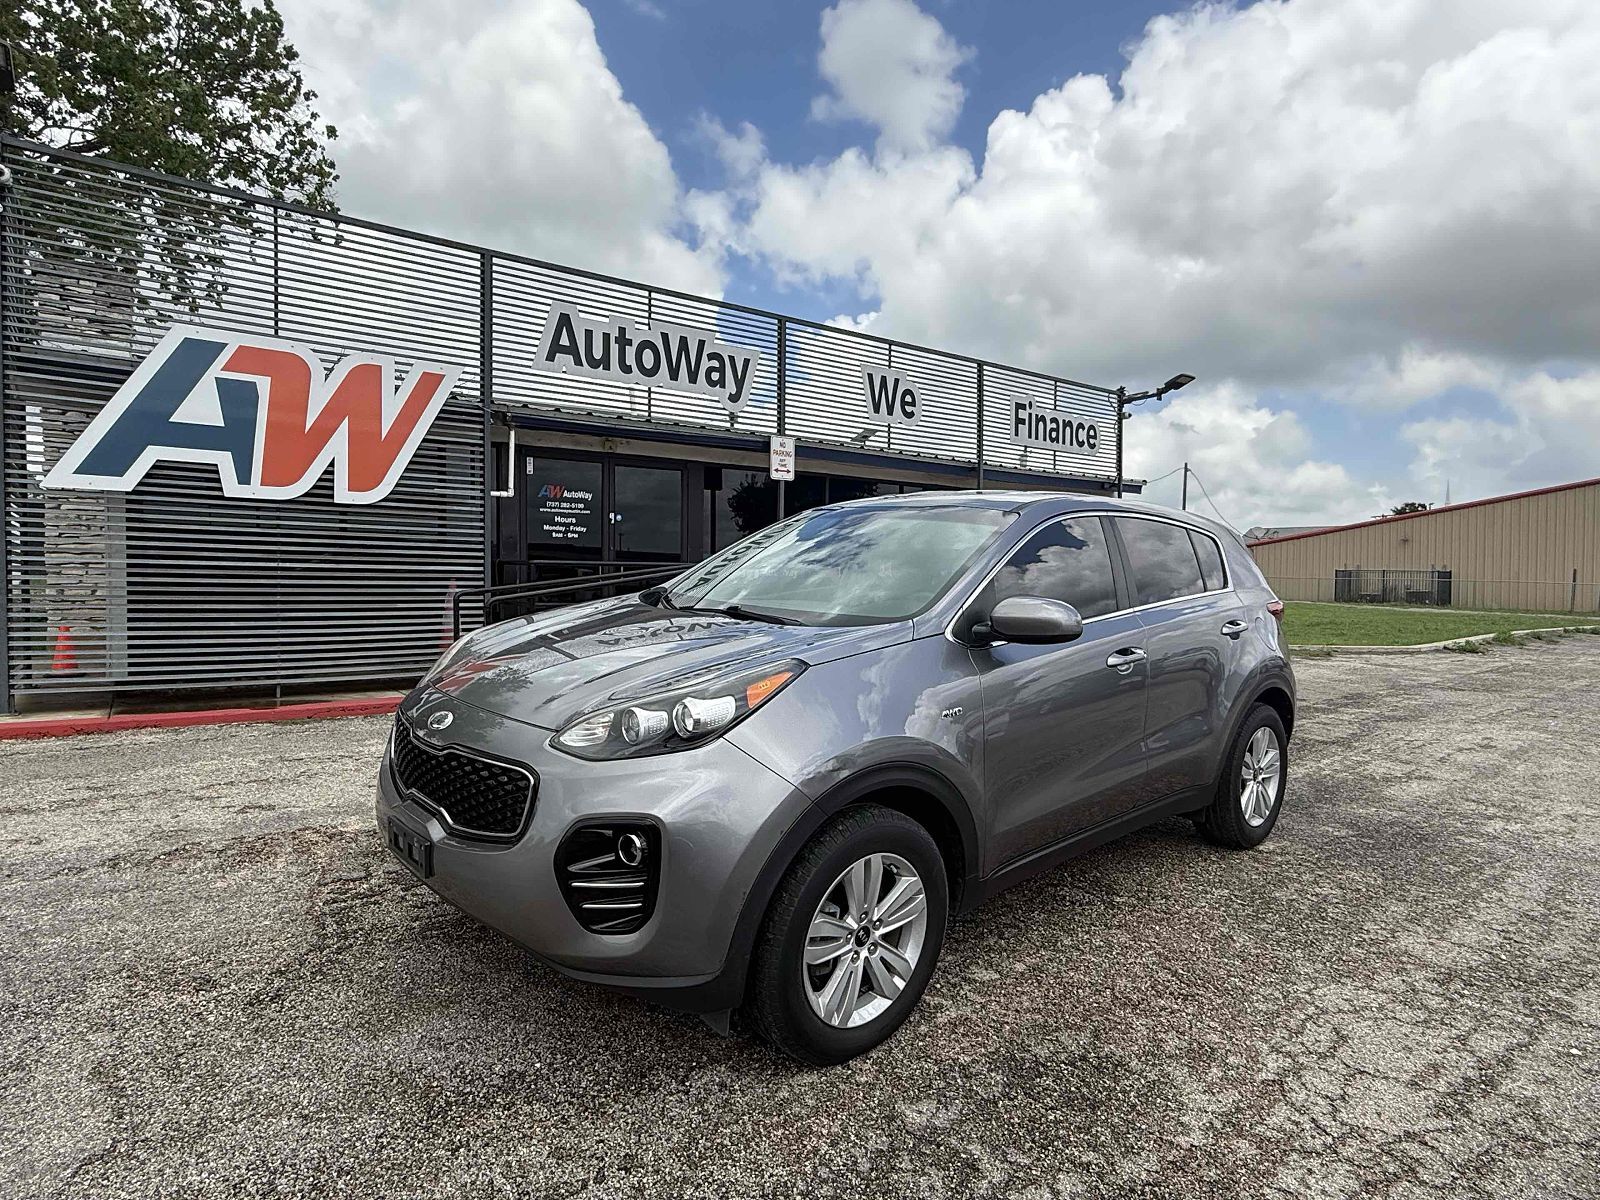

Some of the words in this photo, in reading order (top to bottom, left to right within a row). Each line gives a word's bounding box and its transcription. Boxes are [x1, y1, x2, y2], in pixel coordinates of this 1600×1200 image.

[545, 312, 751, 404] AutoWay
[866, 372, 918, 420] We
[71, 337, 447, 493] AW
[1014, 401, 1098, 450] Finance
[772, 448, 793, 458] PARKING
[562, 490, 592, 501] AutoWay
[543, 524, 566, 532] Monday
[569, 525, 587, 533] Friday
[554, 515, 577, 524] Hours
